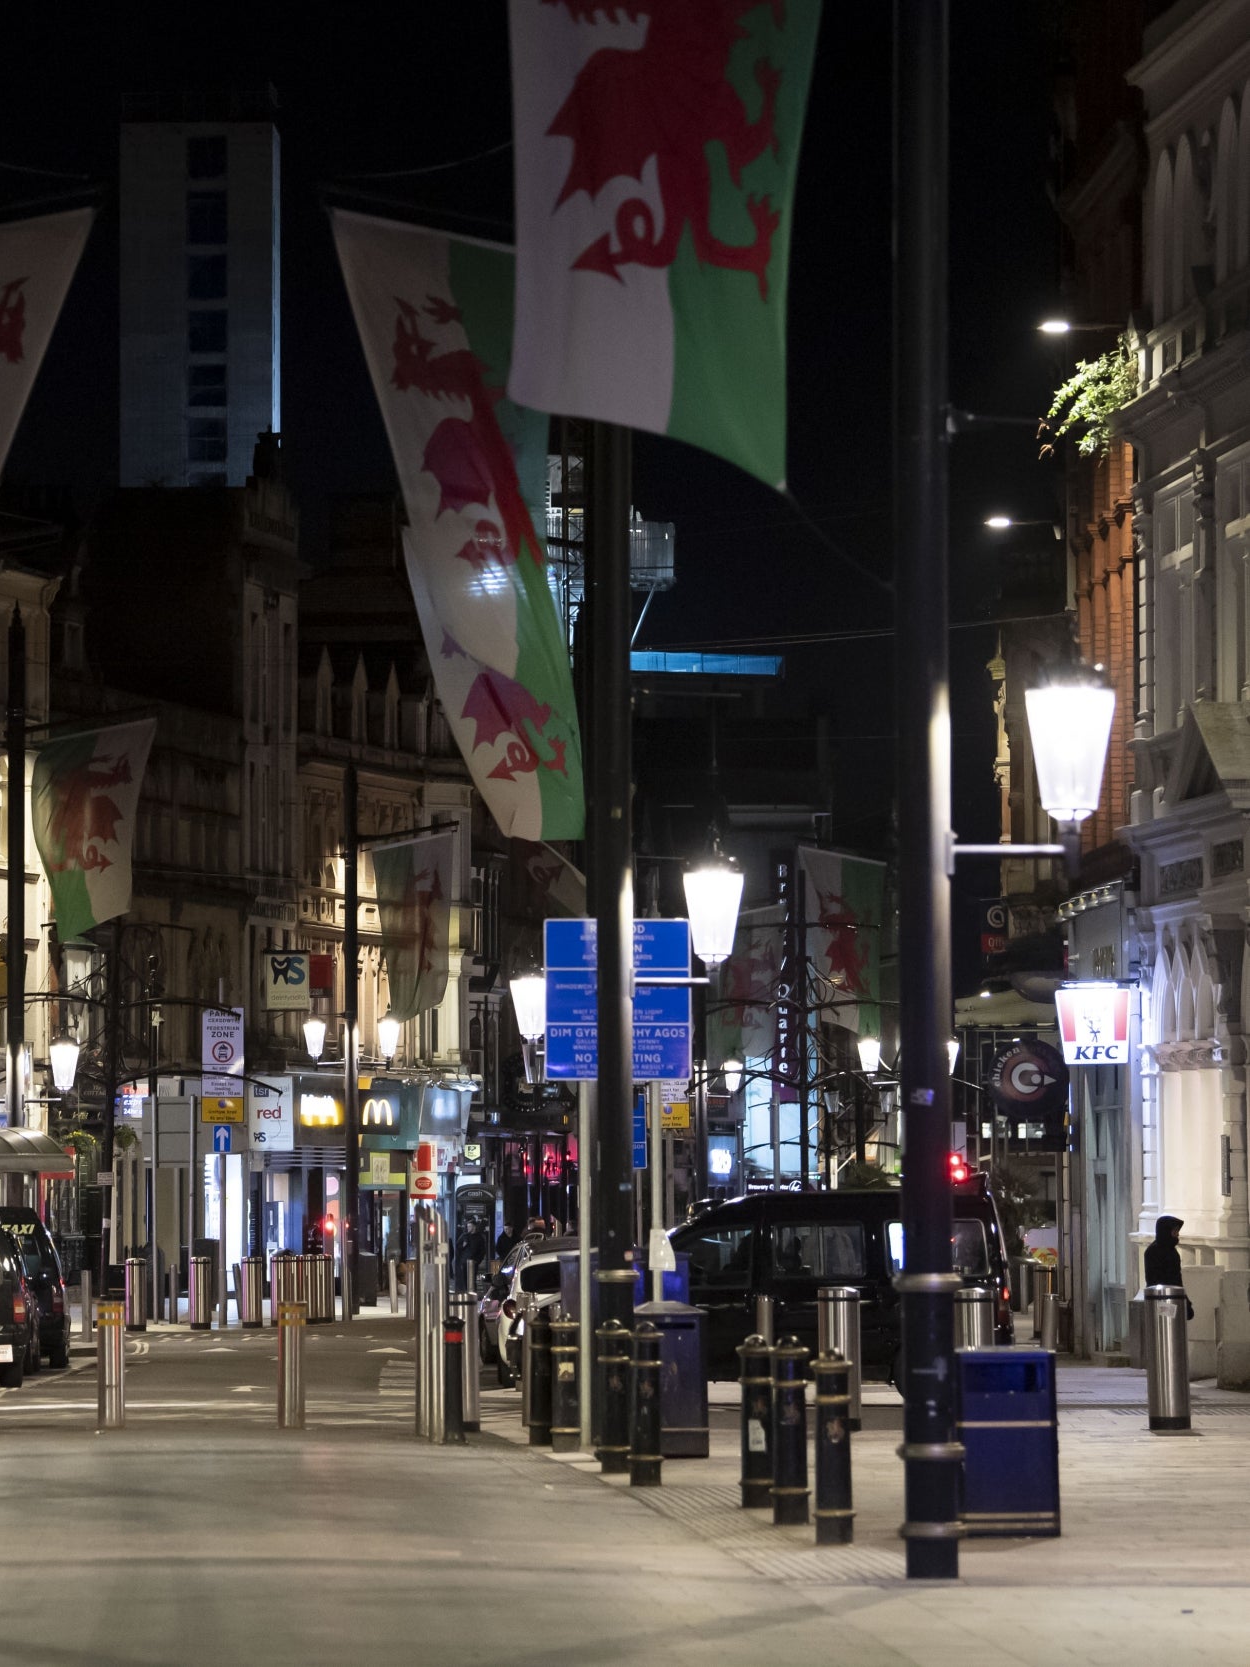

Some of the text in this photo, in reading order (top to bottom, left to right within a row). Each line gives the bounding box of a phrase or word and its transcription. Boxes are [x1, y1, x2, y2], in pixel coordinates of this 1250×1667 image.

[550, 1028, 571, 1038] DIM
[654, 1028, 687, 1038] AGOS
[575, 1053, 592, 1062] NO
[1073, 1045, 1120, 1060] KFC
[254, 1087, 269, 1096] tsr
[256, 1106, 282, 1119] red
[1, 1223, 36, 1235] TAXI
